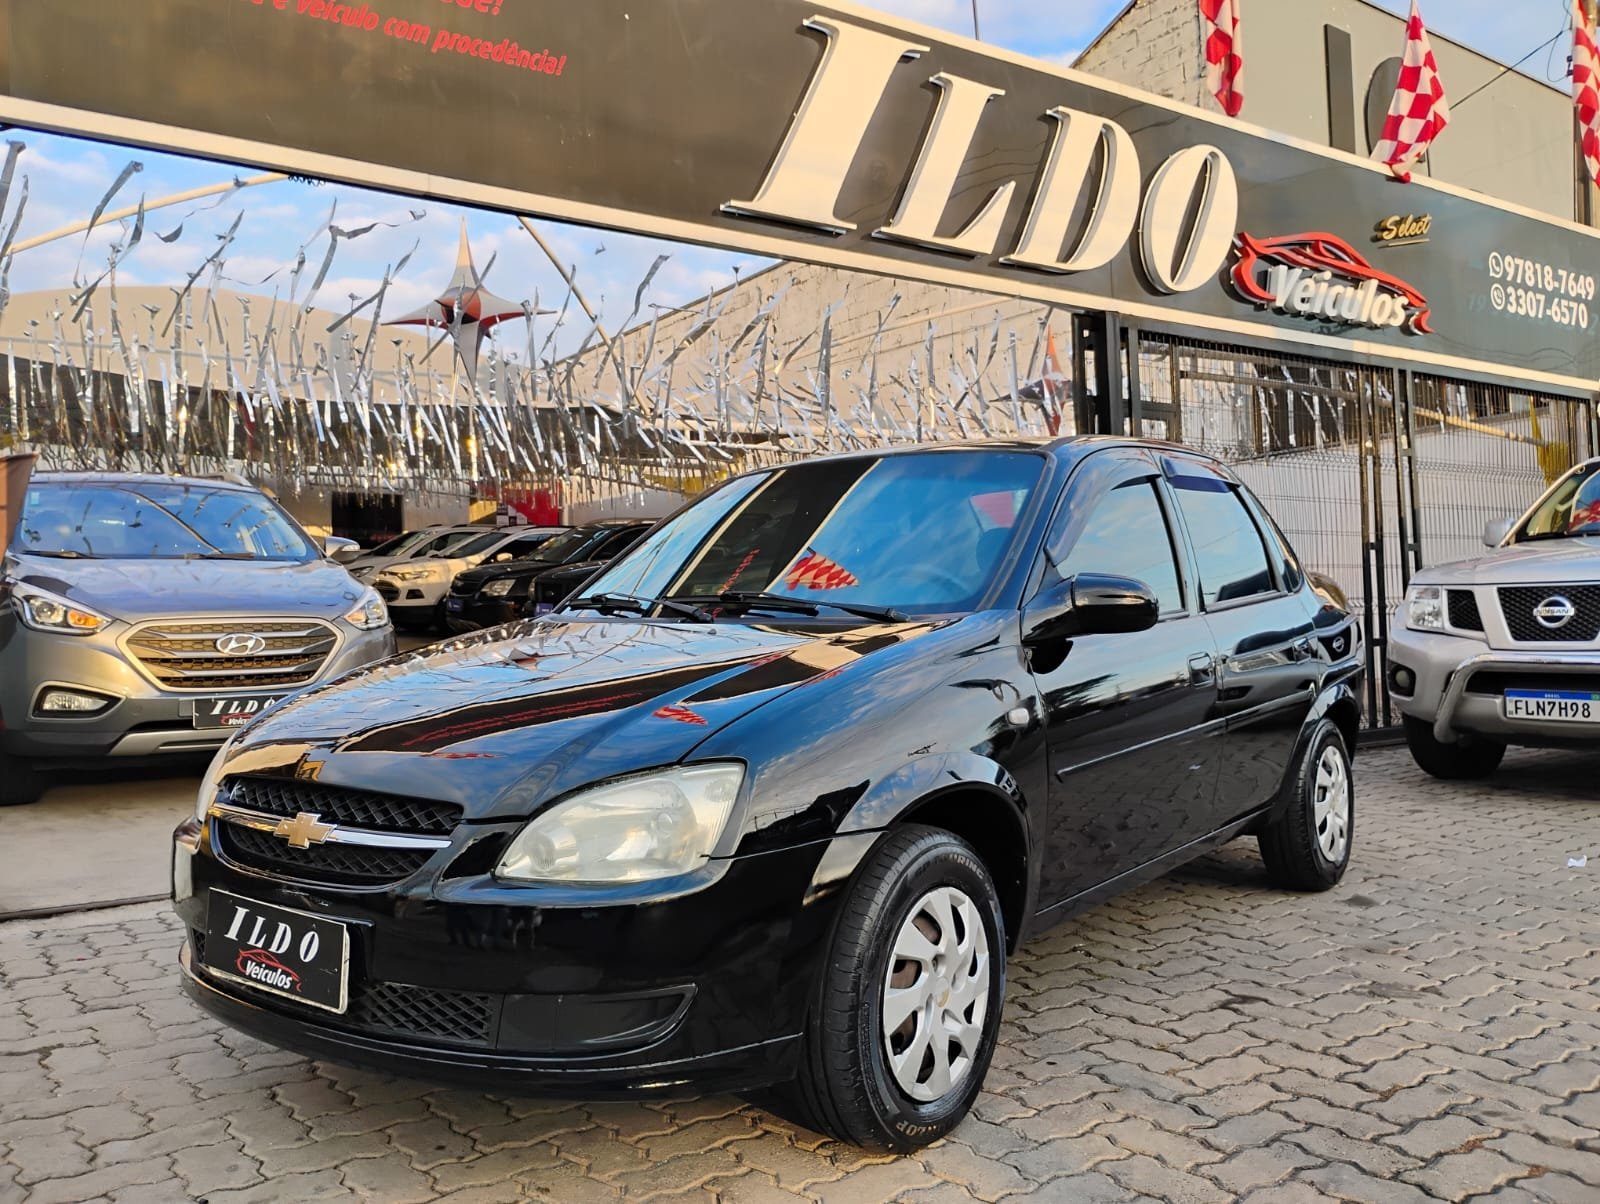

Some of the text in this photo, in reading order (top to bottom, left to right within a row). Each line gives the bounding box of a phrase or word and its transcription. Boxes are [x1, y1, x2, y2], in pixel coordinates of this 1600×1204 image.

[383, 17, 431, 45] com
[431, 30, 568, 77] procedência!
[721, 15, 1238, 294] ILDO
[1379, 212, 1433, 240] Select
[1268, 264, 1410, 328] Veículos
[1504, 254, 1595, 301] 97818-7649
[1506, 285, 1588, 329] 3307-6570
[1514, 699, 1591, 719] FLN7H98
[224, 905, 320, 963] ILDO
